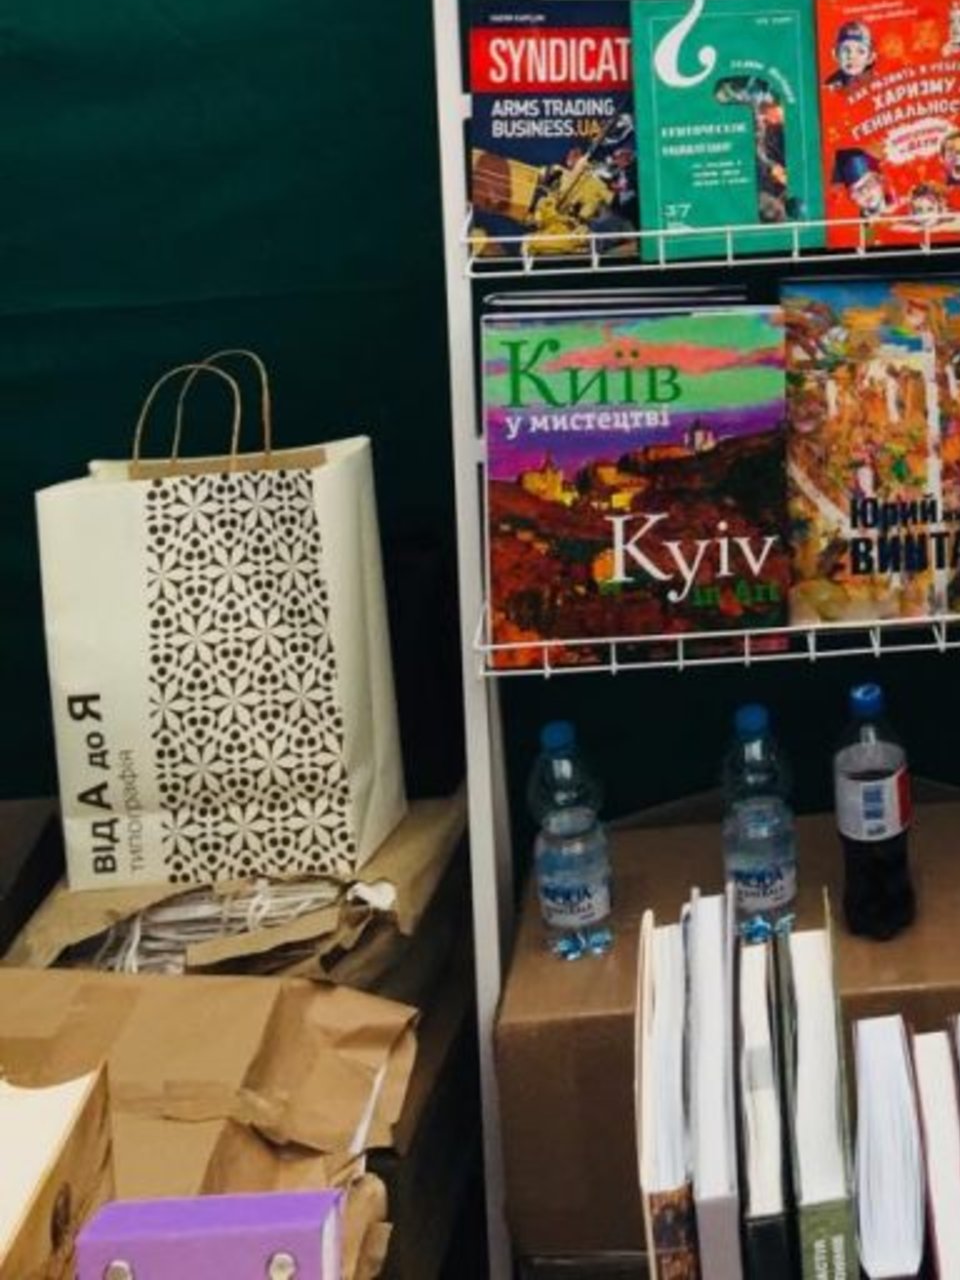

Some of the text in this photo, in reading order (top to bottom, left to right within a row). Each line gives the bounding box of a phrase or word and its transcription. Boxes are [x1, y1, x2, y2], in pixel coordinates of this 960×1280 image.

[488, 36, 631, 84] SYNDICAT
[491, 98, 615, 117] ARMS TRADING
[500, 337, 684, 409] Київ
[505, 406, 671, 440] у мистецтві
[604, 513, 780, 602] Kyiv
[67, 693, 102, 723] Я
[87, 732, 111, 771] до
[78, 782, 110, 812] А
